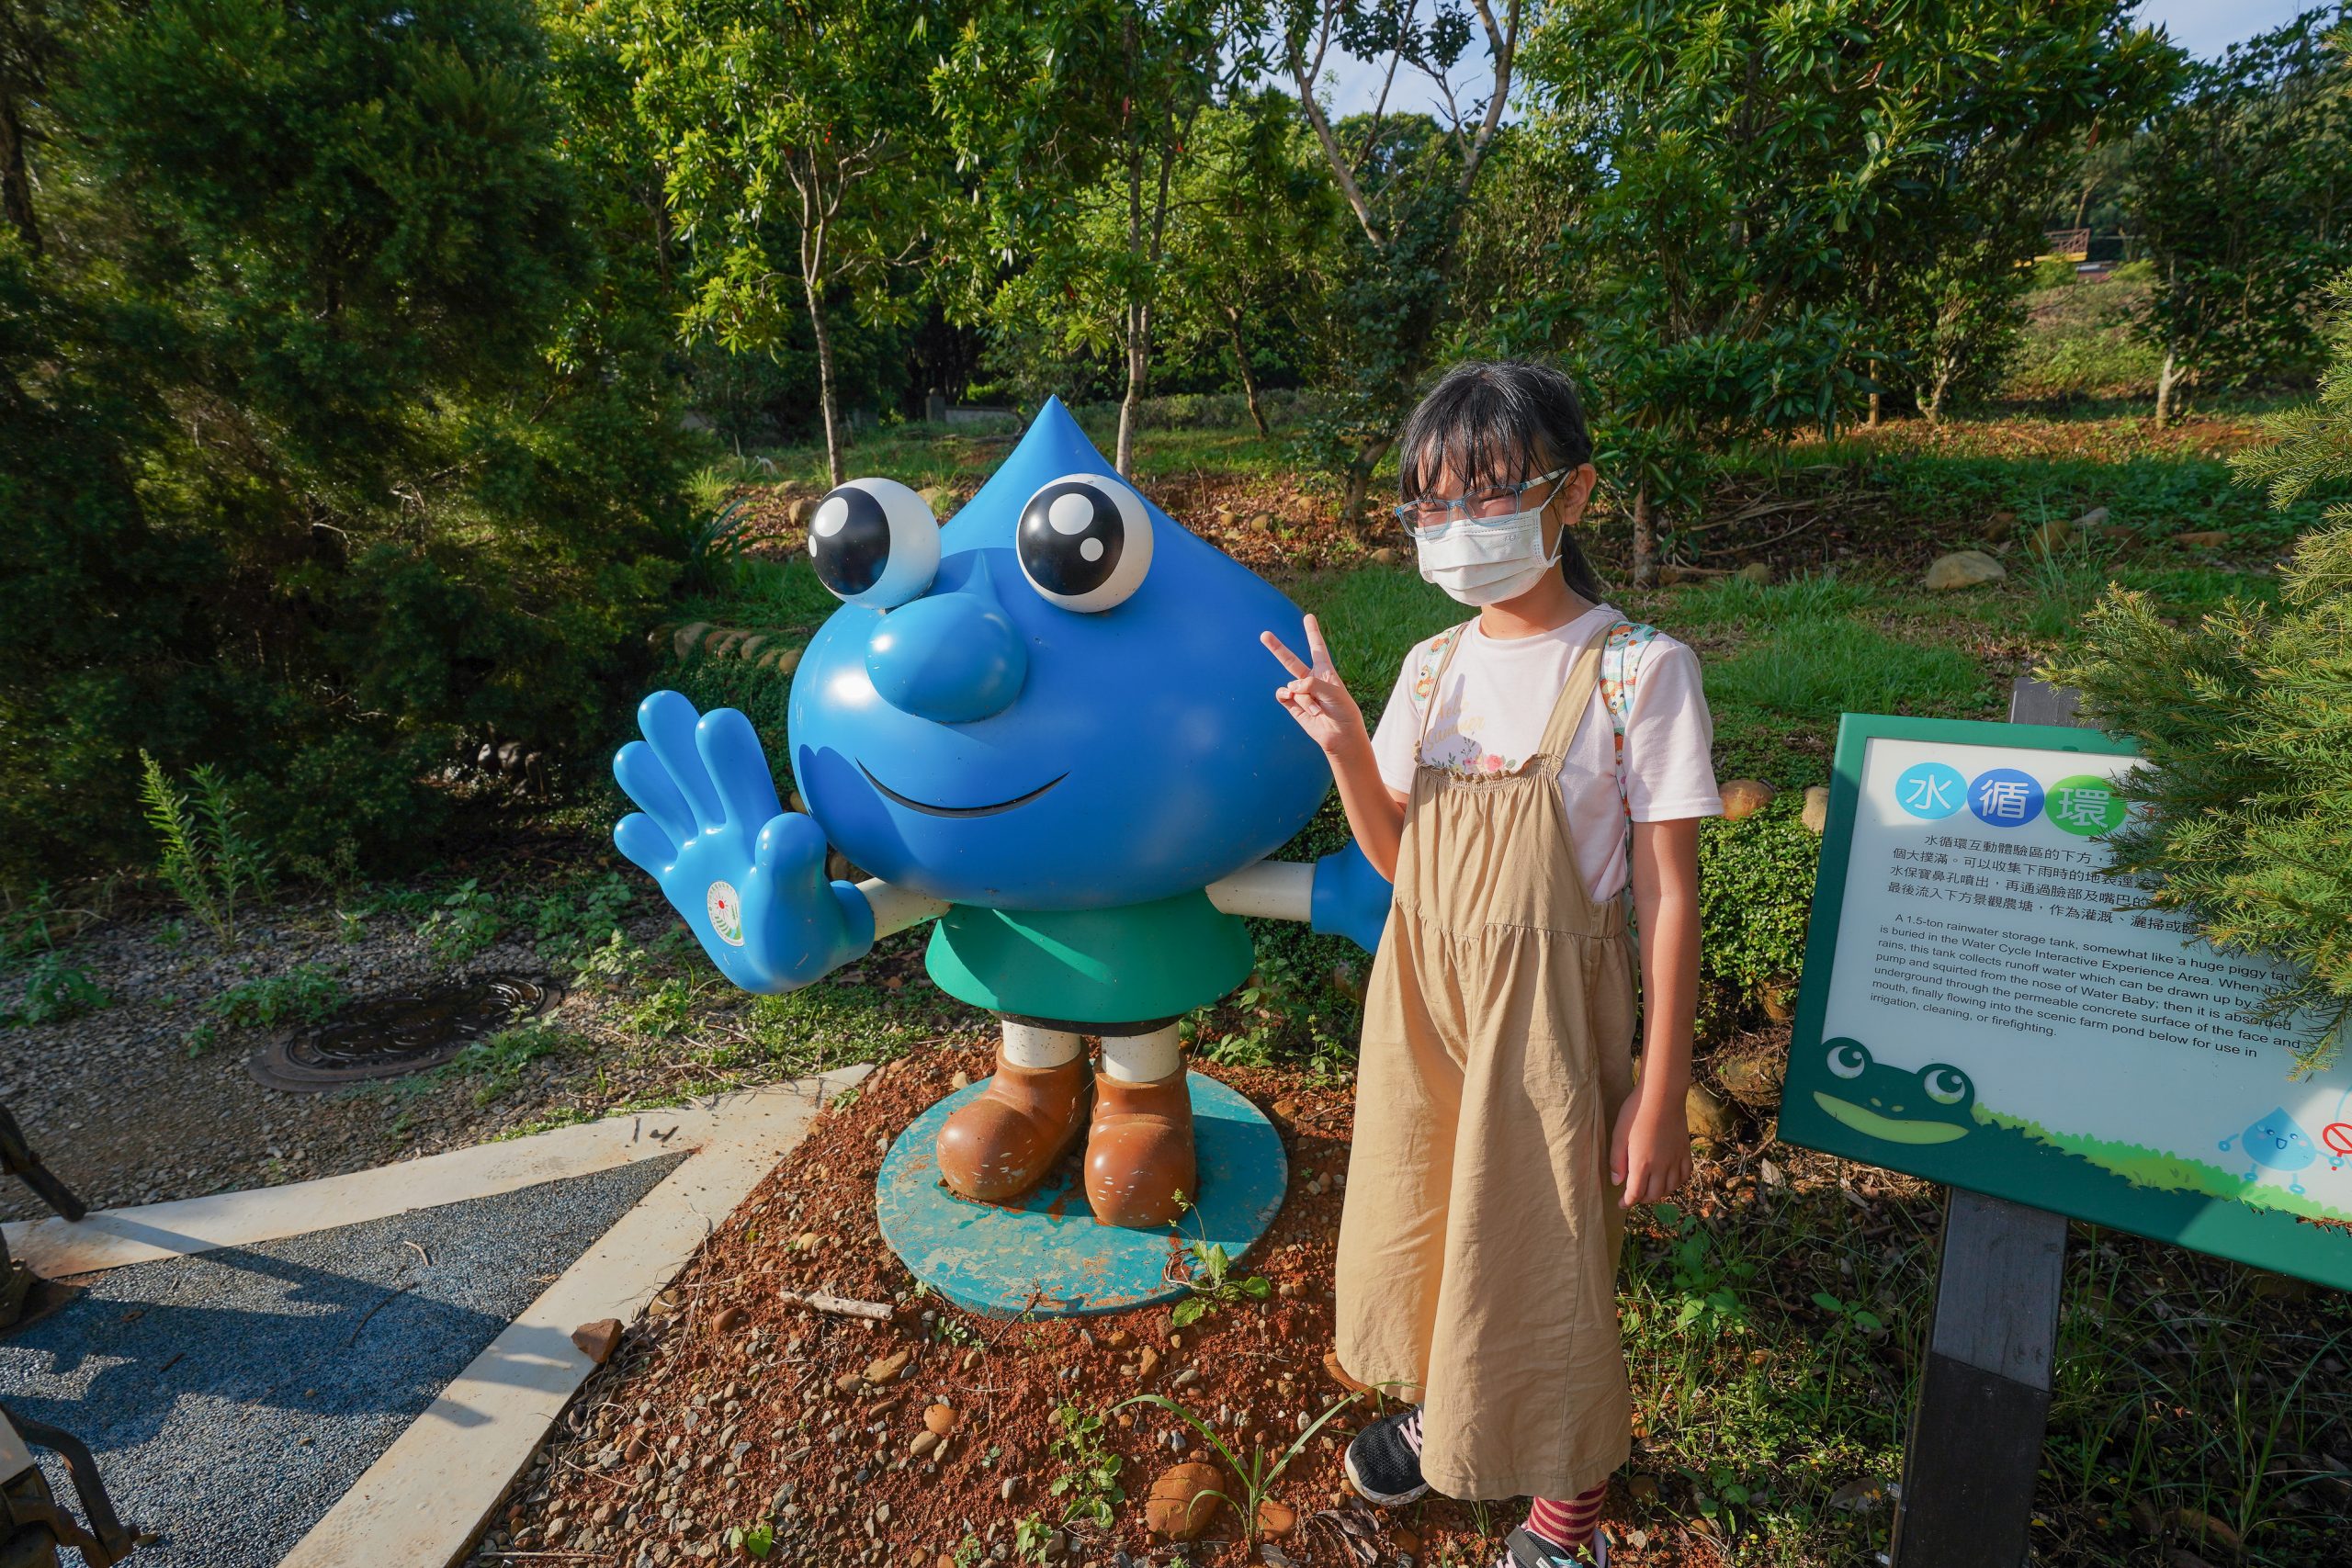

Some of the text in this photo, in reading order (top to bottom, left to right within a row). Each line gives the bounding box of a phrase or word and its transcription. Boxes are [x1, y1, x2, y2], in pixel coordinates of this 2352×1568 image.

[1905, 773, 2110, 829] 水循環
[1879, 941, 1906, 951] rains,
[1911, 944, 1928, 953] this
[1933, 948, 1955, 958] tank
[1960, 953, 2001, 965] collects
[2006, 962, 2040, 972] runoff
[2042, 967, 2076, 977] water
[2080, 973, 2115, 985] which
[2120, 980, 2143, 989] can
[2147, 983, 2163, 993] be
[2167, 987, 2208, 1000] drawn
[2213, 996, 2230, 1005] up
[2235, 998, 2252, 1009] by
[1892, 927, 1925, 939] buried
[1928, 932, 1937, 941] in
[1941, 935, 1958, 944] the
[1962, 938, 1996, 950] Water
[1999, 944, 2030, 956] Cycle
[2036, 950, 2098, 966] Interactive
[2102, 960, 2174, 979] Experience
[2177, 972, 2212, 986] Area.
[2219, 978, 2258, 992] When
[1895, 914, 1903, 922] A
[1907, 916, 1943, 928] 1.5-ton
[1947, 923, 1999, 936] rainwater
[2002, 931, 2045, 944] storage
[2050, 937, 2077, 950] tank,
[2083, 944, 2148, 960] somewhat
[2152, 953, 2174, 964] like
[2177, 957, 2186, 965] a
[2191, 958, 2224, 972] huge
[2229, 966, 2267, 979] piggy
[1871, 995, 1918, 1010] irrigation,
[1923, 1004, 1972, 1021] cleaning,
[1992, 1016, 2057, 1036] firefighting.
[1875, 967, 2300, 1050] underground through the permeable concrete surface of the face and
[1876, 954, 1905, 965] pump
[1909, 960, 1929, 968] and
[1933, 964, 1977, 976] squirted
[1981, 970, 2006, 981] from
[2010, 976, 2028, 985] the
[2032, 980, 2061, 990] nose
[2081, 987, 2119, 1000] Water
[2122, 994, 2158, 1009] Baby;
[2164, 1001, 2192, 1013] then
[2198, 1007, 2205, 1016] it
[2210, 1009, 2220, 1018] is
[1872, 981, 2256, 1057] mouth, finally flowing into the scenic farm pond below for use in
